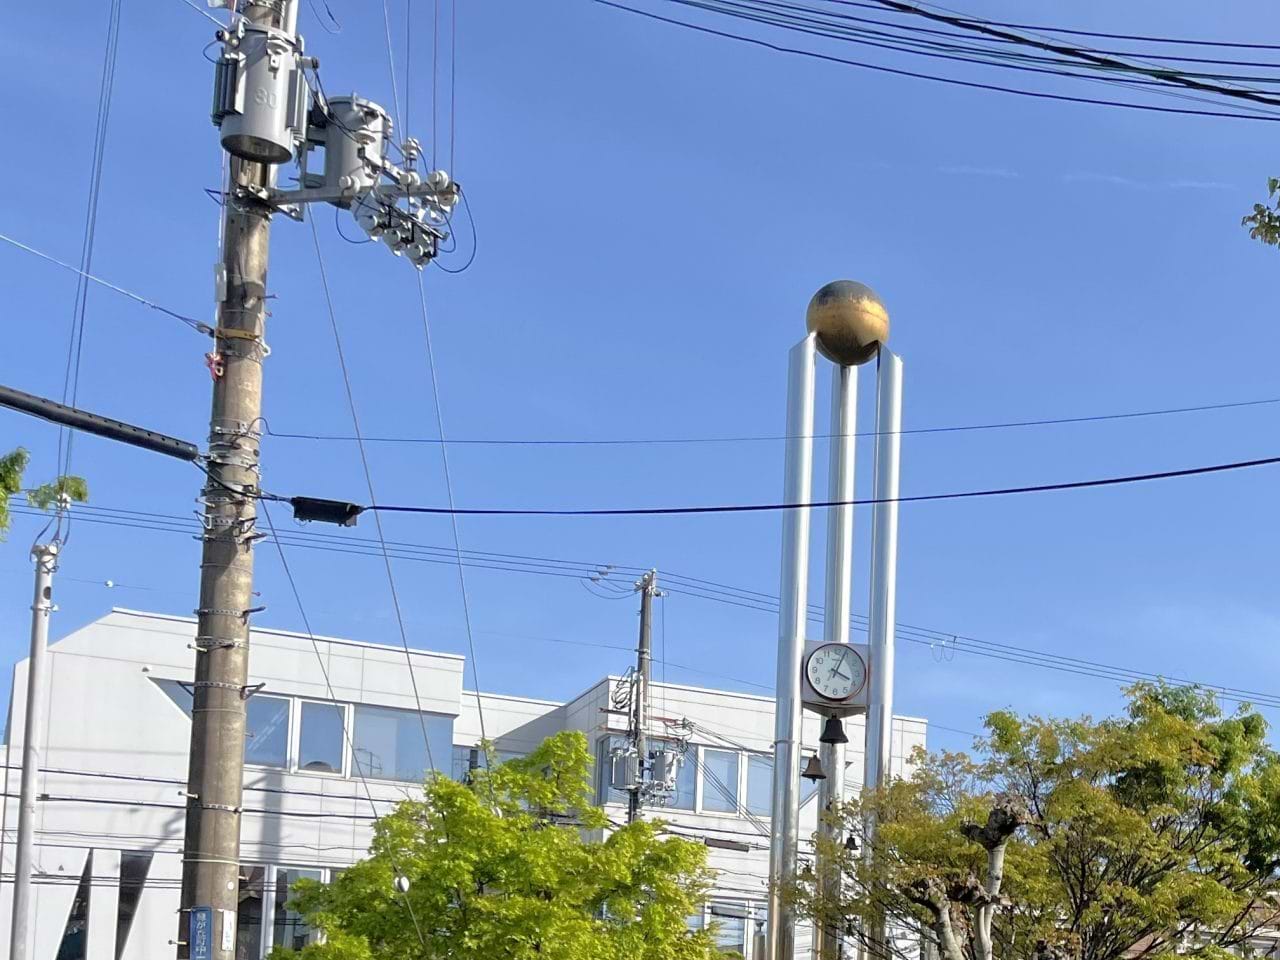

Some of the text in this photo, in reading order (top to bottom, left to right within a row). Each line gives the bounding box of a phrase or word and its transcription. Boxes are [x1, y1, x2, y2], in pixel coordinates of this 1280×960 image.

[823, 650, 831, 658] 11
[815, 657, 824, 665] 10
[812, 666, 818, 674] 9
[815, 677, 821, 685] 8
[823, 684, 829, 692] 7
[842, 686, 848, 694] 5
